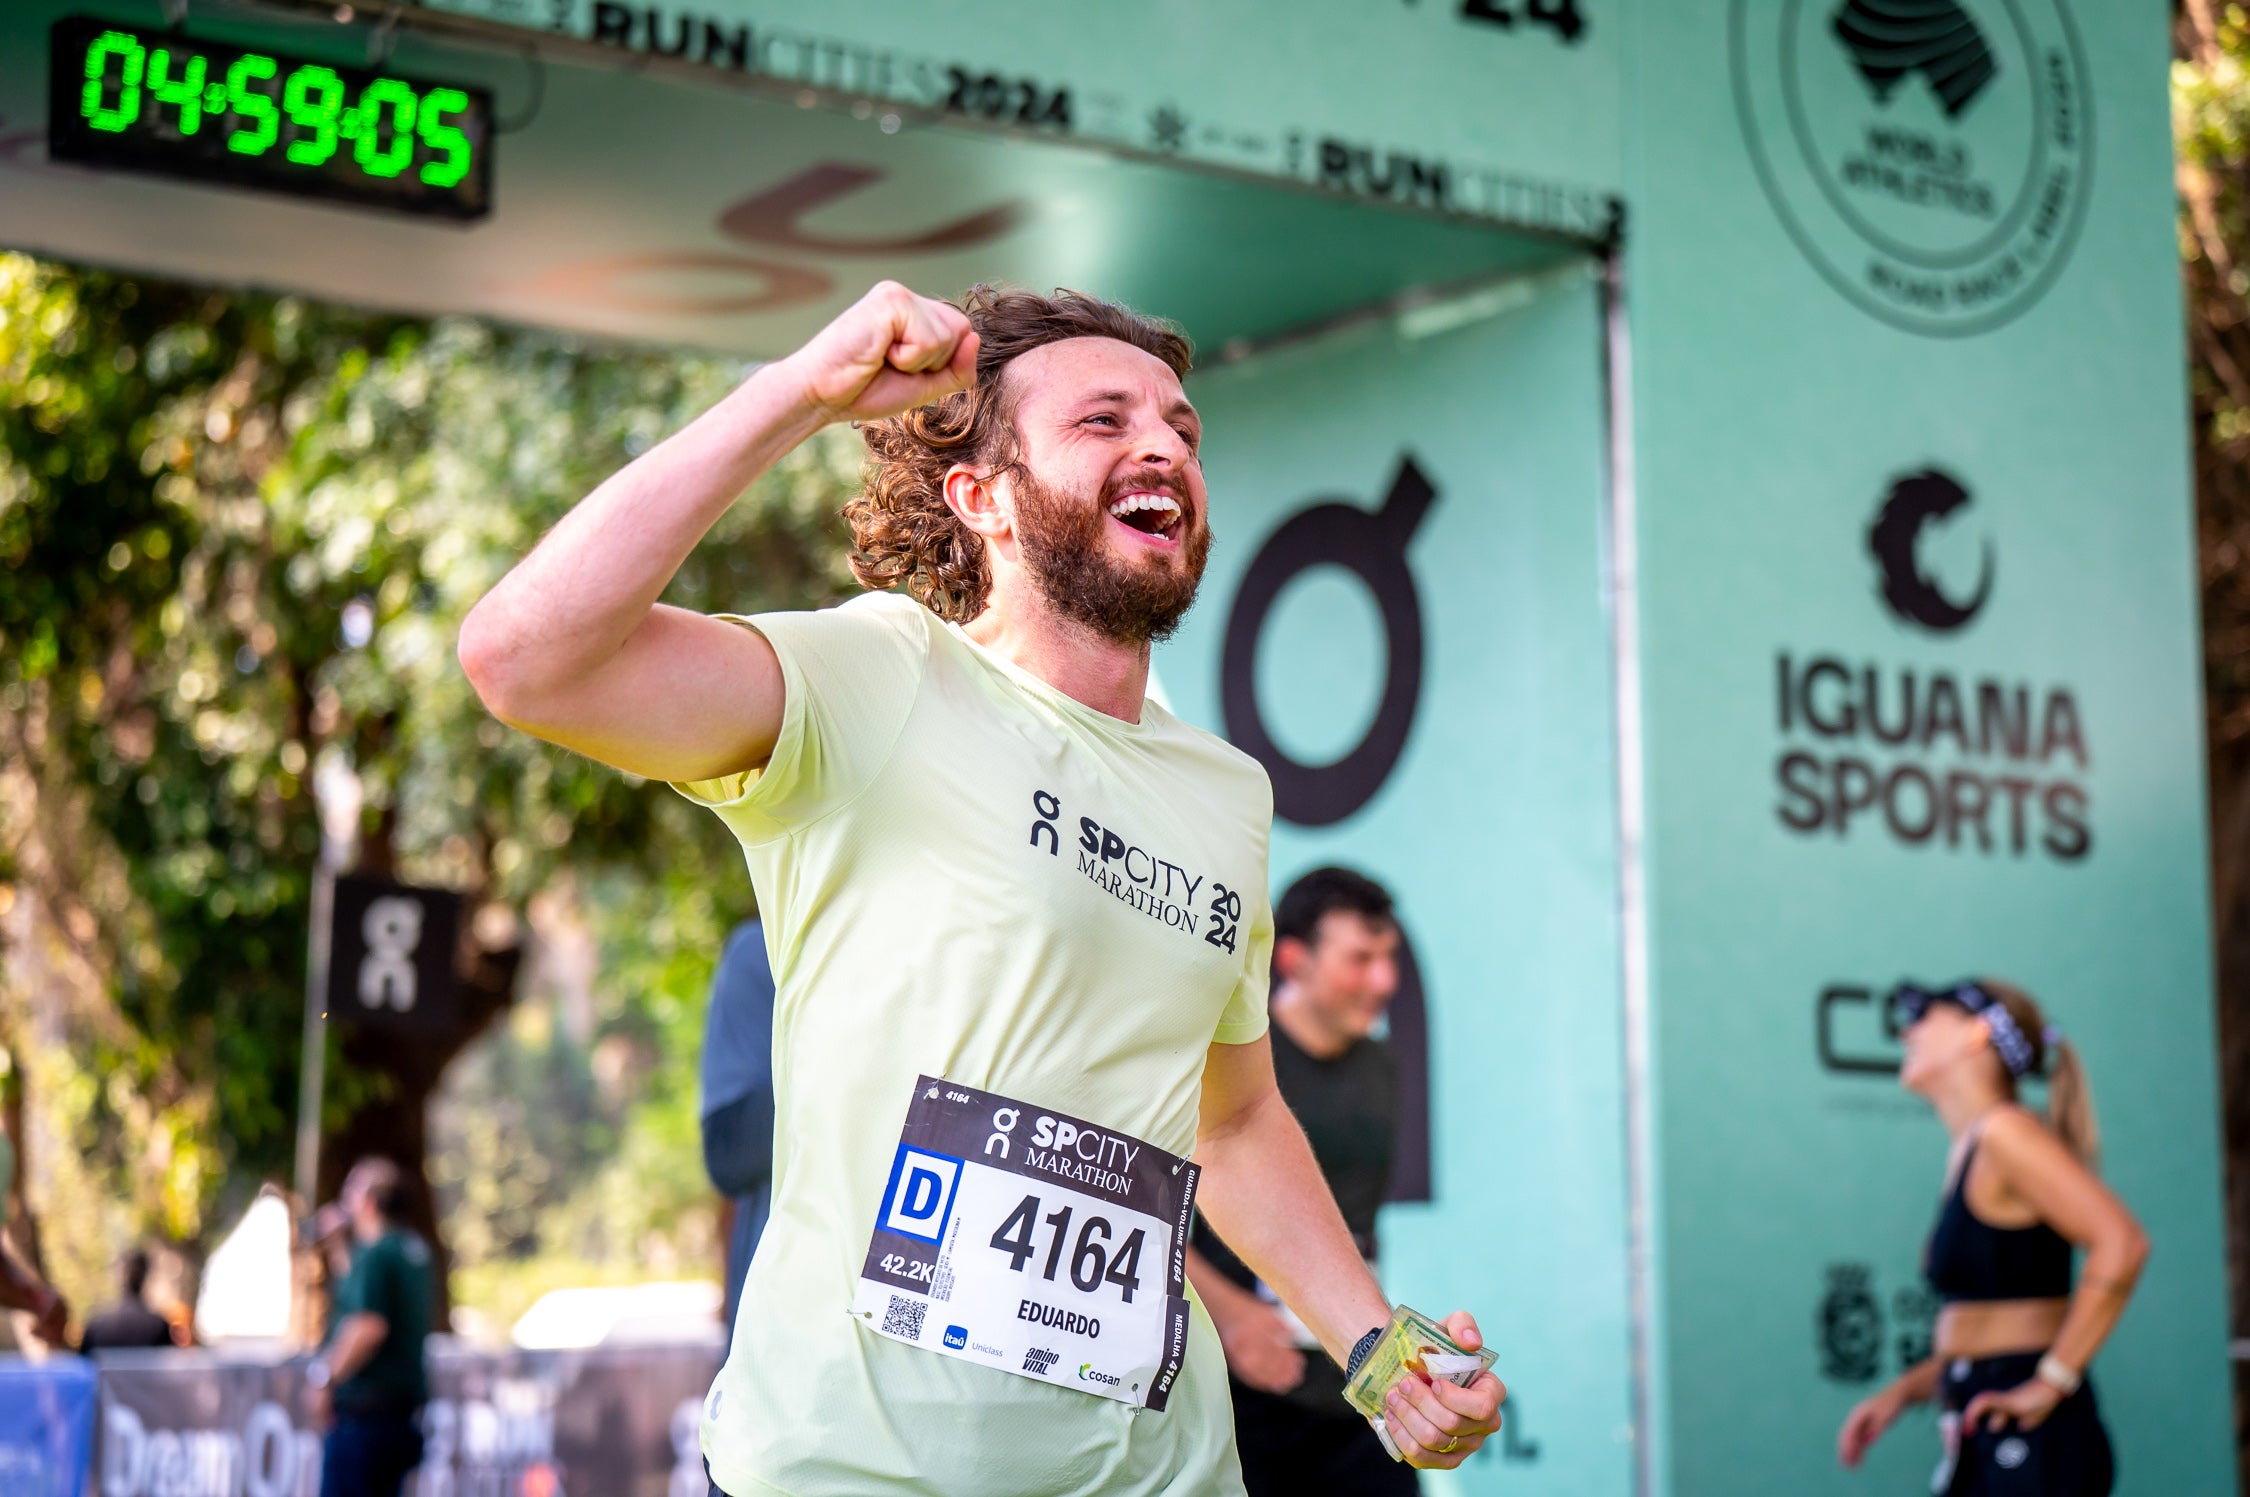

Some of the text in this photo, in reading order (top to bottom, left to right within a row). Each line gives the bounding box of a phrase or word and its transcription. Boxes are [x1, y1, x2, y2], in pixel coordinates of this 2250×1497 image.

[81, 30, 471, 188] 04:59:05
[1773, 648, 2091, 771] IGUANA
[1773, 749, 2092, 862] SPORTS
[1076, 850, 1199, 935] MARATHON
[1210, 882, 1241, 922] 20
[1205, 914, 1237, 955] 24
[946, 1090, 970, 1104] 4164
[1025, 1147, 1133, 1195] MARATHON
[900, 1166, 942, 1221] D
[1173, 1169, 1195, 1283] GUARDA-VOLUME 4164
[880, 1253, 935, 1284] 42.2K
[989, 1195, 1146, 1304] 4164
[1017, 1299, 1101, 1339] EDUARDO
[972, 1342, 1003, 1357] Uniclass
[1022, 1359, 1048, 1376] VITAL
[1025, 1347, 1060, 1365] amino
[1159, 1314, 1183, 1393] MEDALHA 4164
[1089, 1370, 1120, 1387] cosan
